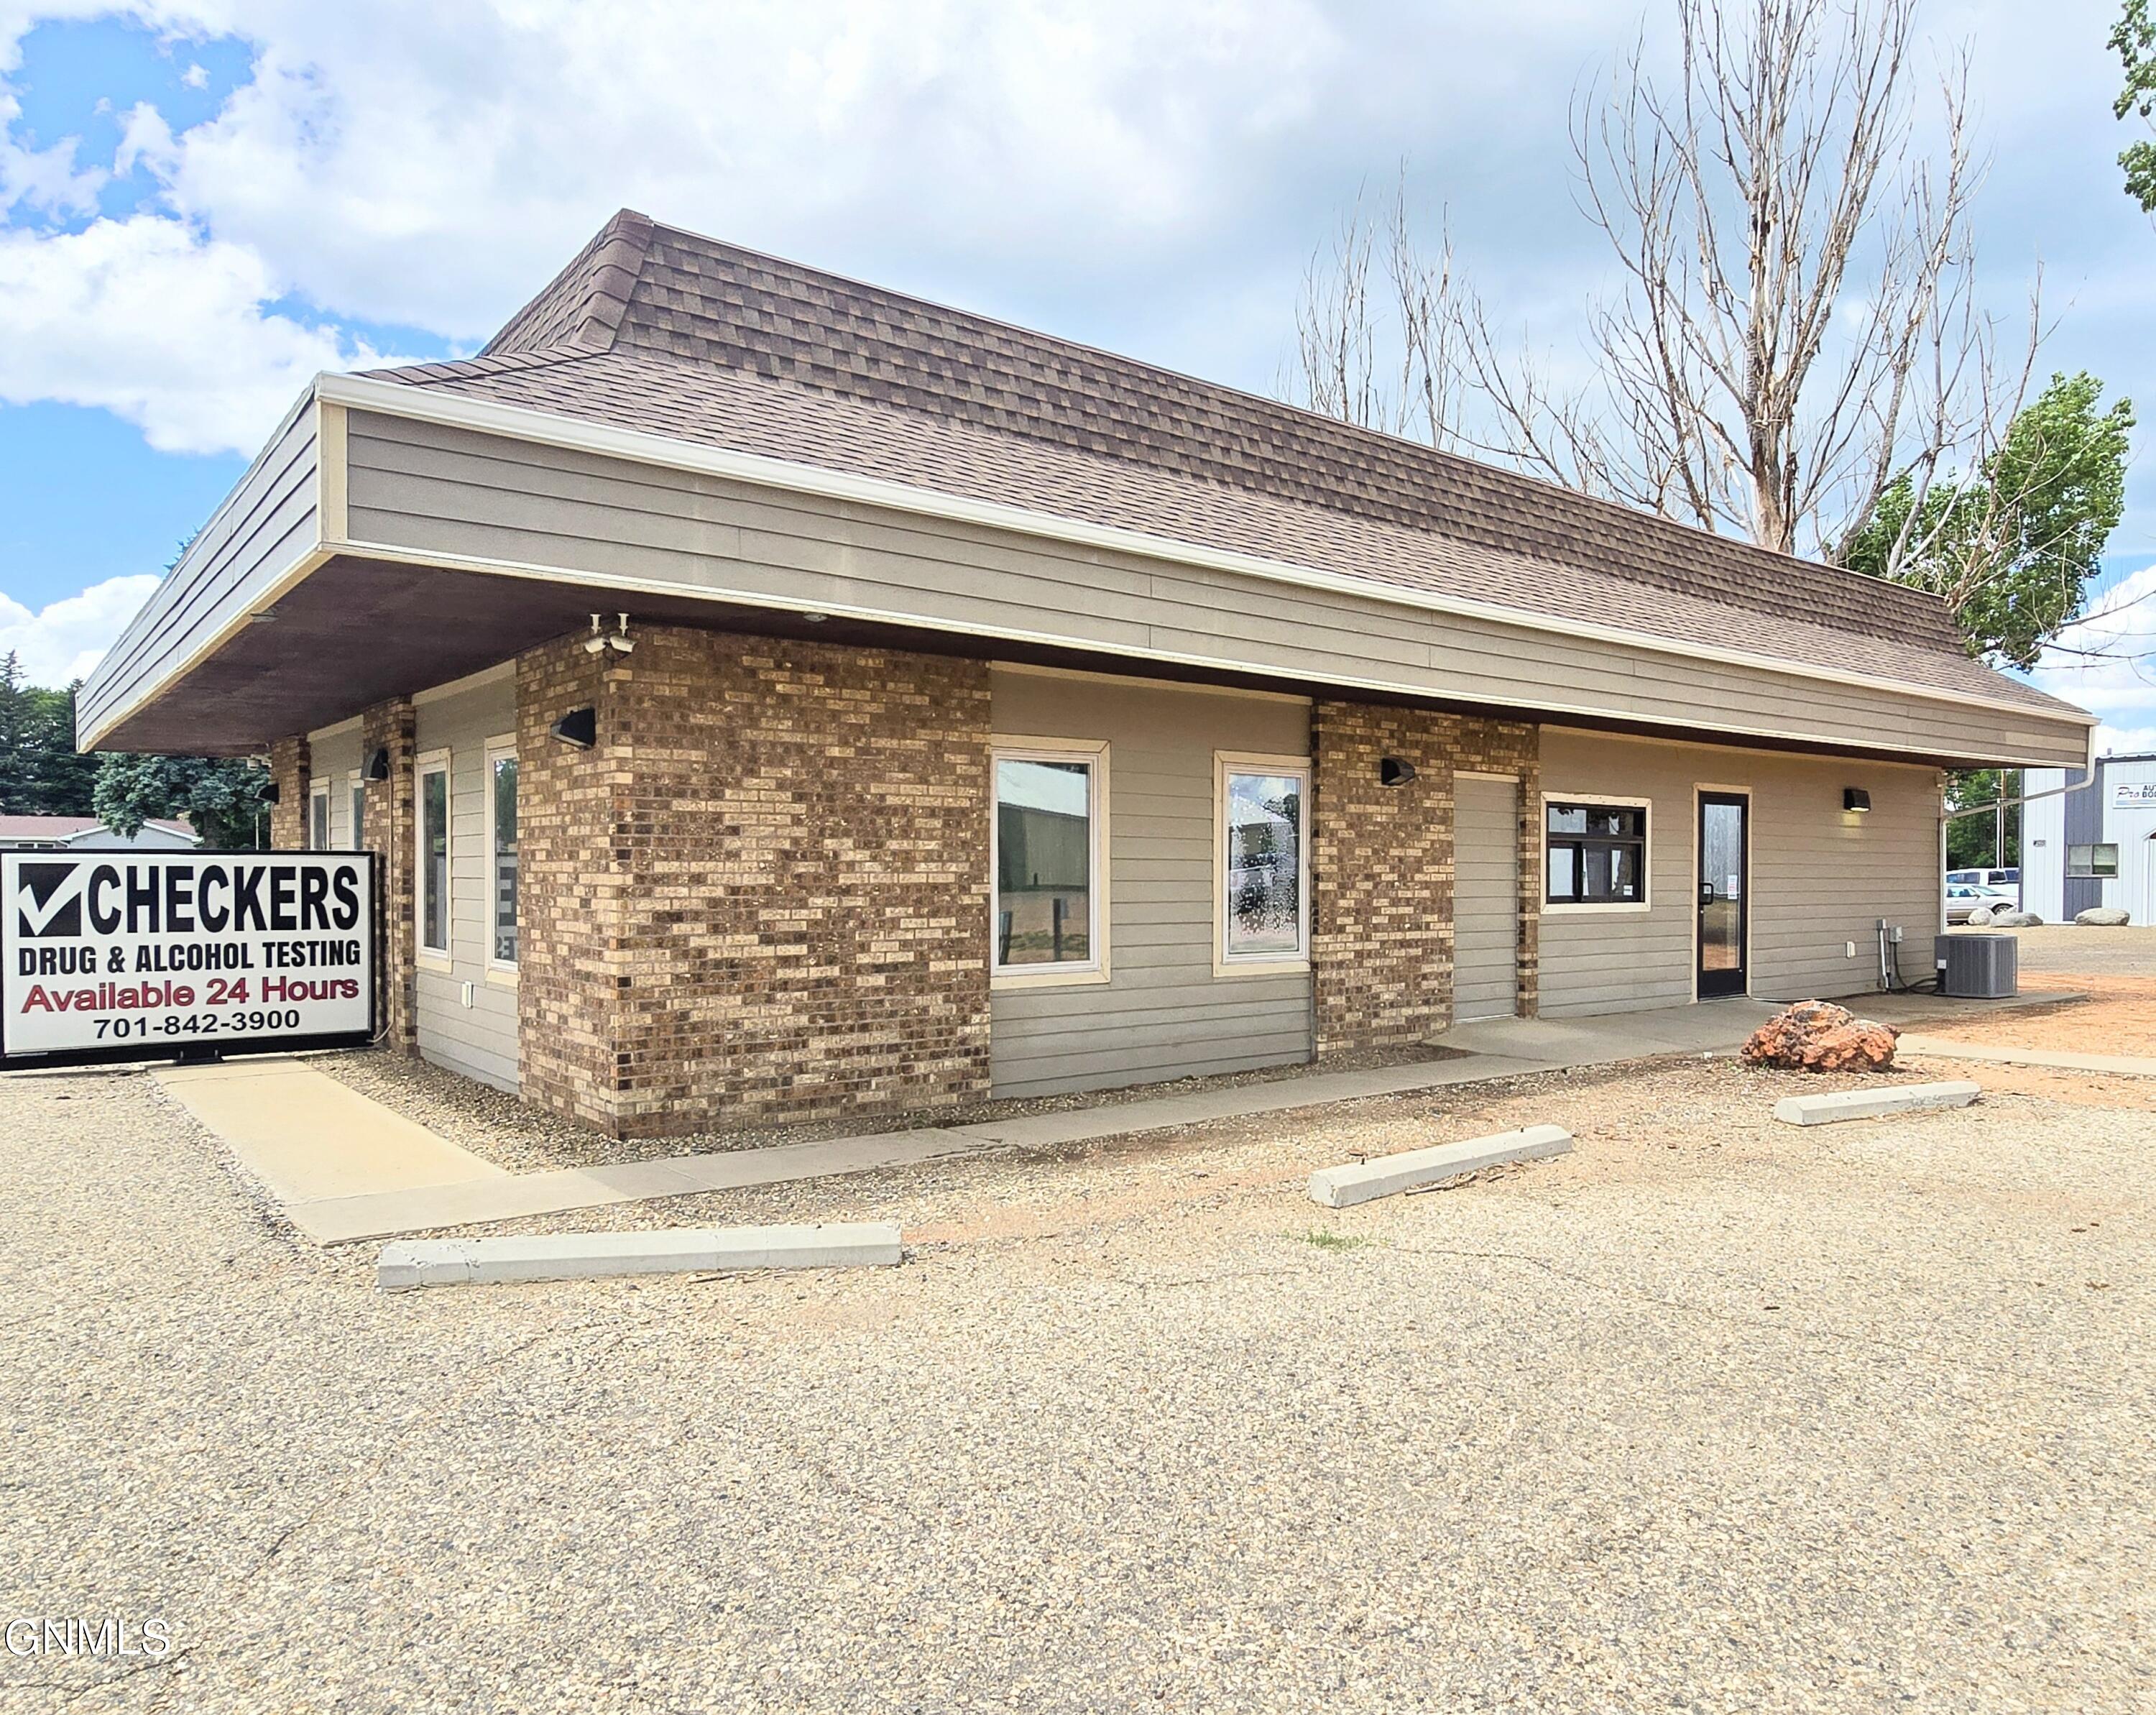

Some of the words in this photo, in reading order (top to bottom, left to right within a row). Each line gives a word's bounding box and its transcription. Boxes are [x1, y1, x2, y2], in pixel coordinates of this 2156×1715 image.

[88, 864, 359, 935] CHECKERS
[19, 946, 96, 976] DRUG
[107, 946, 126, 973] &
[135, 942, 254, 973] ALCOHOL
[262, 939, 361, 968] TESTING
[20, 980, 195, 1013] Available
[206, 977, 250, 1005] 24
[262, 975, 359, 1003] Hours
[93, 1009, 300, 1039] 701-842-3900
